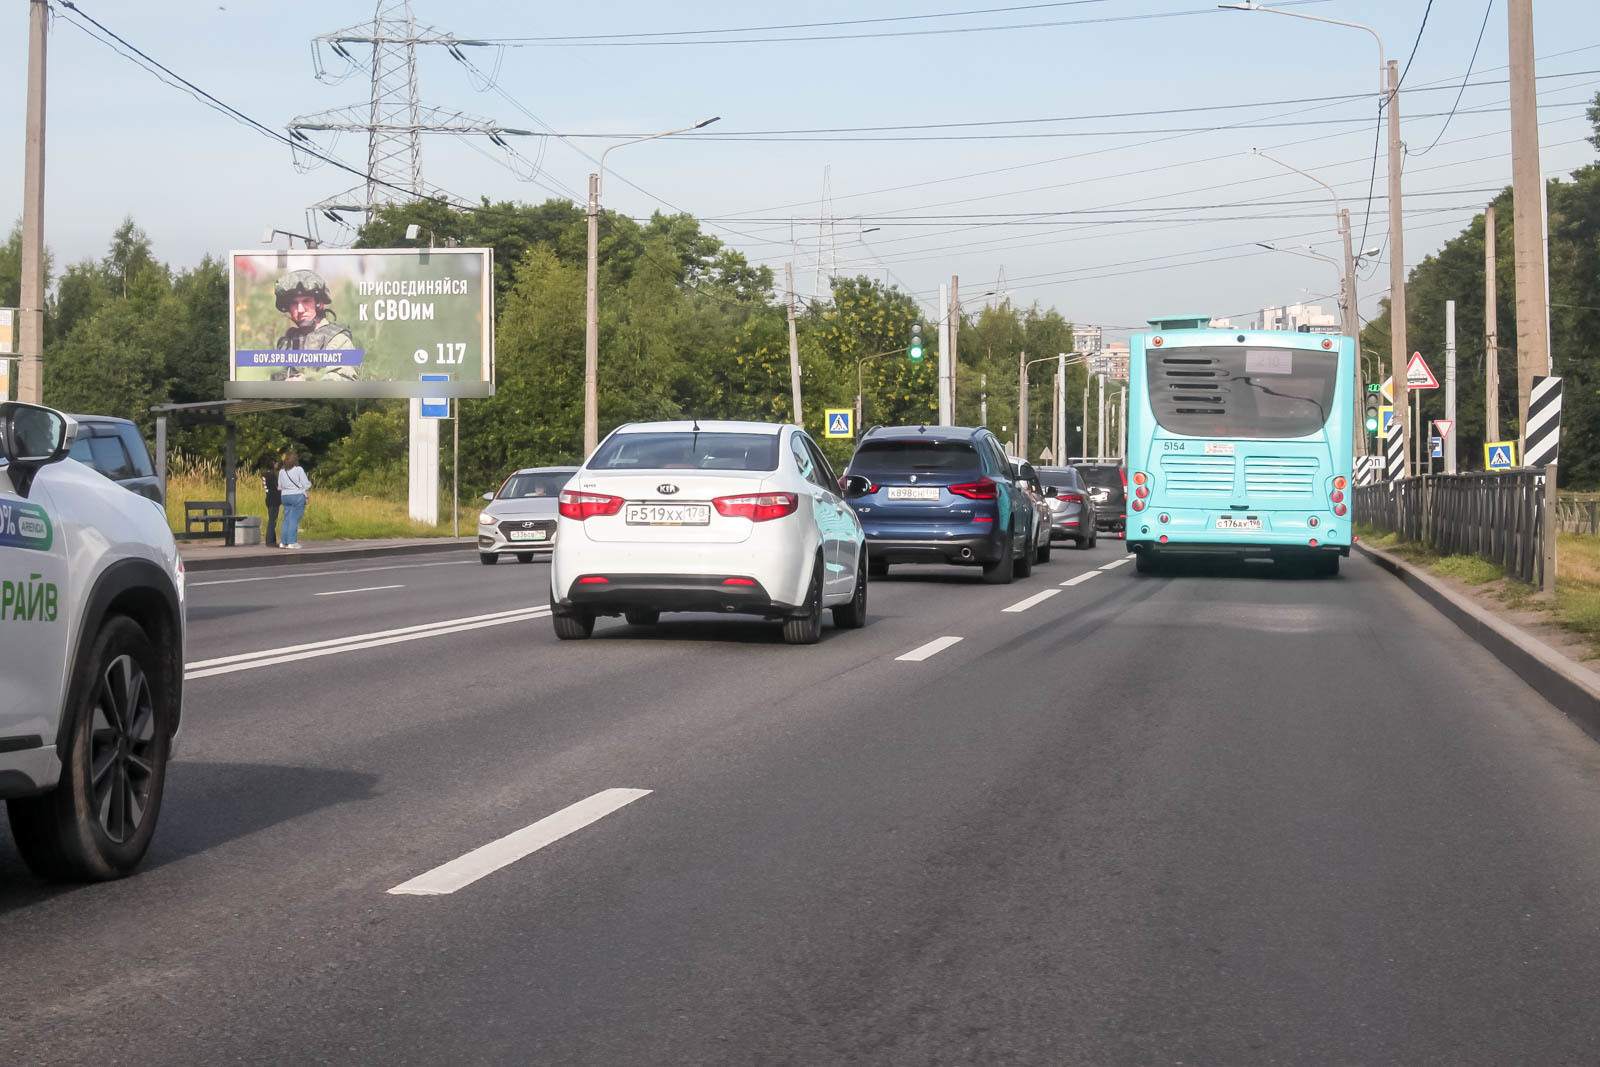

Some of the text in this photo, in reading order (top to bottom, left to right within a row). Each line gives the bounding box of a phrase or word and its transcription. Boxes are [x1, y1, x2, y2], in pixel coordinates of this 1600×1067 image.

[359, 277, 468, 297] ПРИСОЕДИНЯЙСЯ
[374, 299, 435, 321] СВОим
[253, 352, 343, 364] GOV.SPB.RU/CONTRACT
[436, 342, 467, 364] 117
[1163, 441, 1185, 451] 5154
[659, 484, 677, 494] KIA
